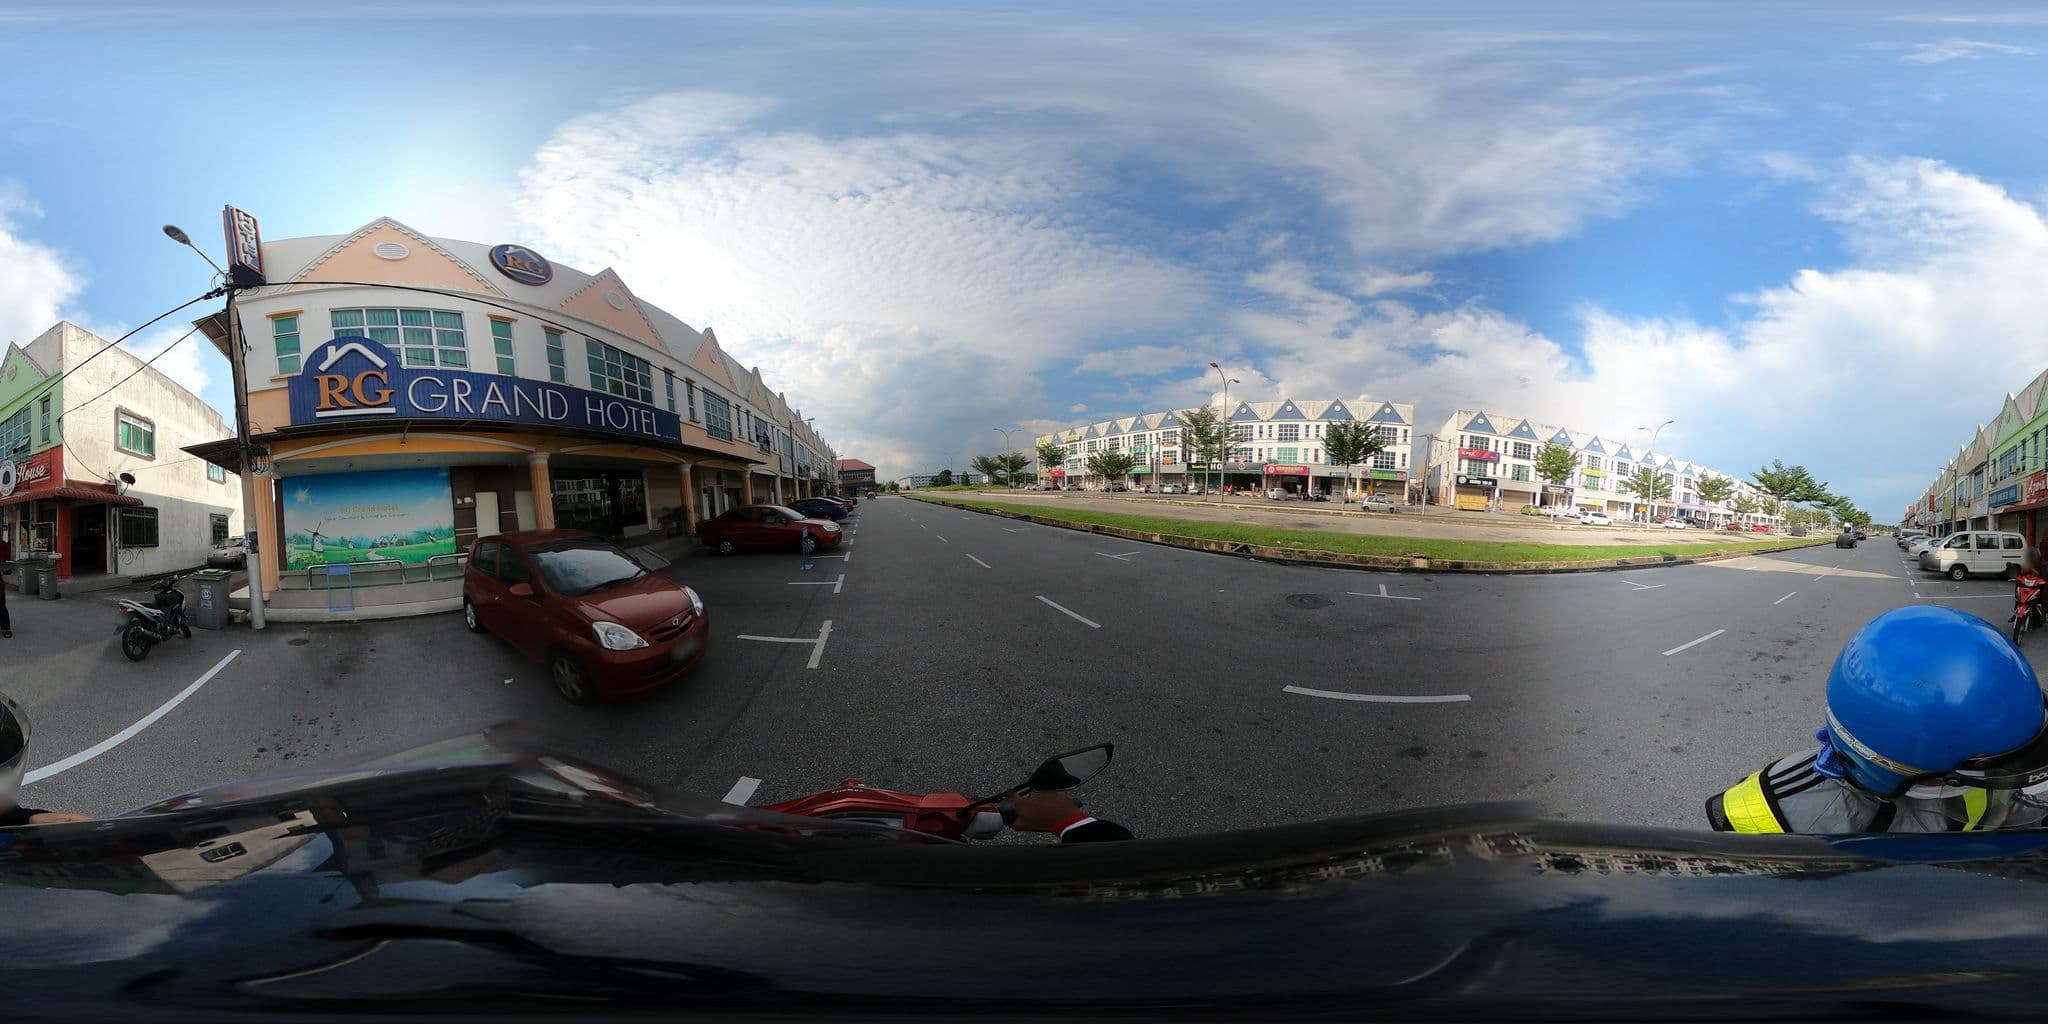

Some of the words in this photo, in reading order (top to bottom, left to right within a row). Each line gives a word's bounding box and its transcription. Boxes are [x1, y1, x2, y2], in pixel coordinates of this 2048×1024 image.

[504, 253, 544, 275] RG
[313, 370, 395, 410] RG
[408, 376, 569, 421] GRAND
[585, 396, 661, 437] HOTEL
[16, 463, 46, 484] House
